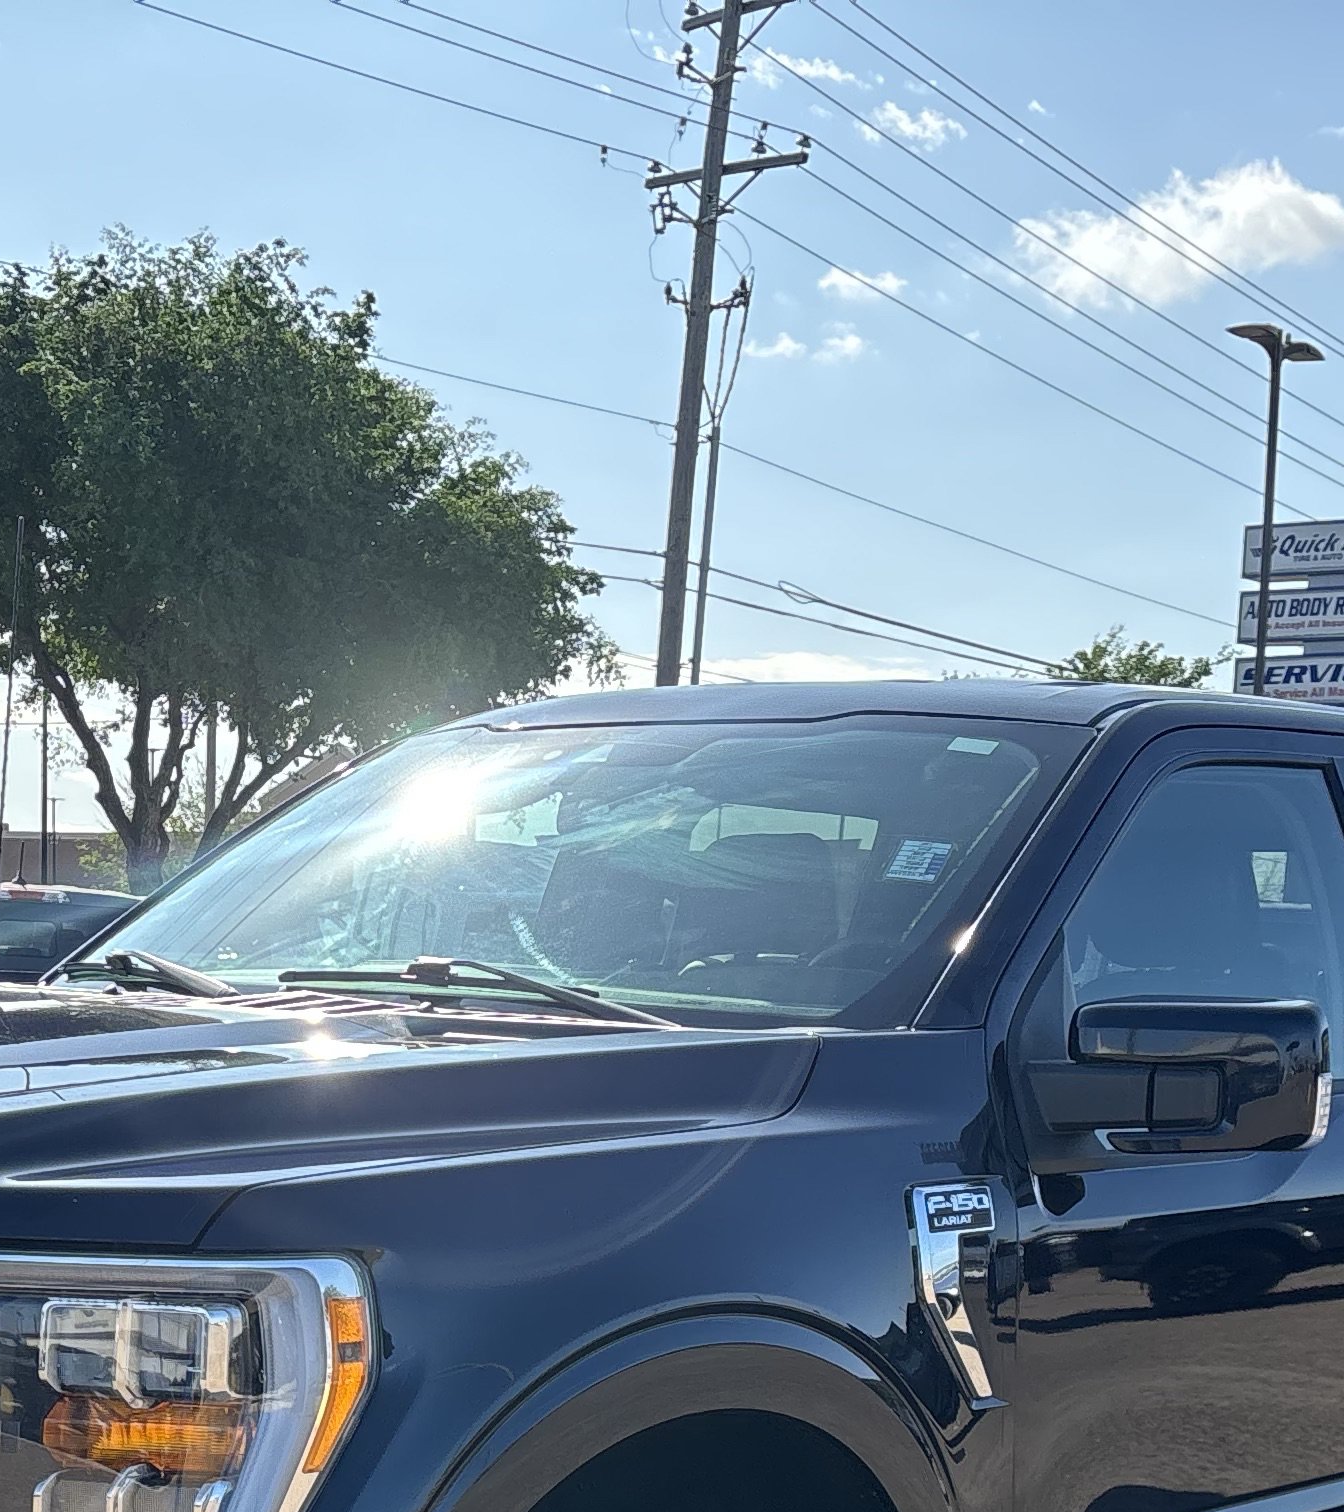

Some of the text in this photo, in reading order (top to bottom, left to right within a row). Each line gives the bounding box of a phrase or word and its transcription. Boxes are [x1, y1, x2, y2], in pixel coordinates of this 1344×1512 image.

[1279, 533, 1340, 556] Quick
[1243, 599, 1287, 620] ATO
[1288, 597, 1333, 617] BODY
[1310, 687, 1325, 697] All
[927, 1193, 990, 1214] F-150
[933, 1213, 974, 1227] LARIAT
